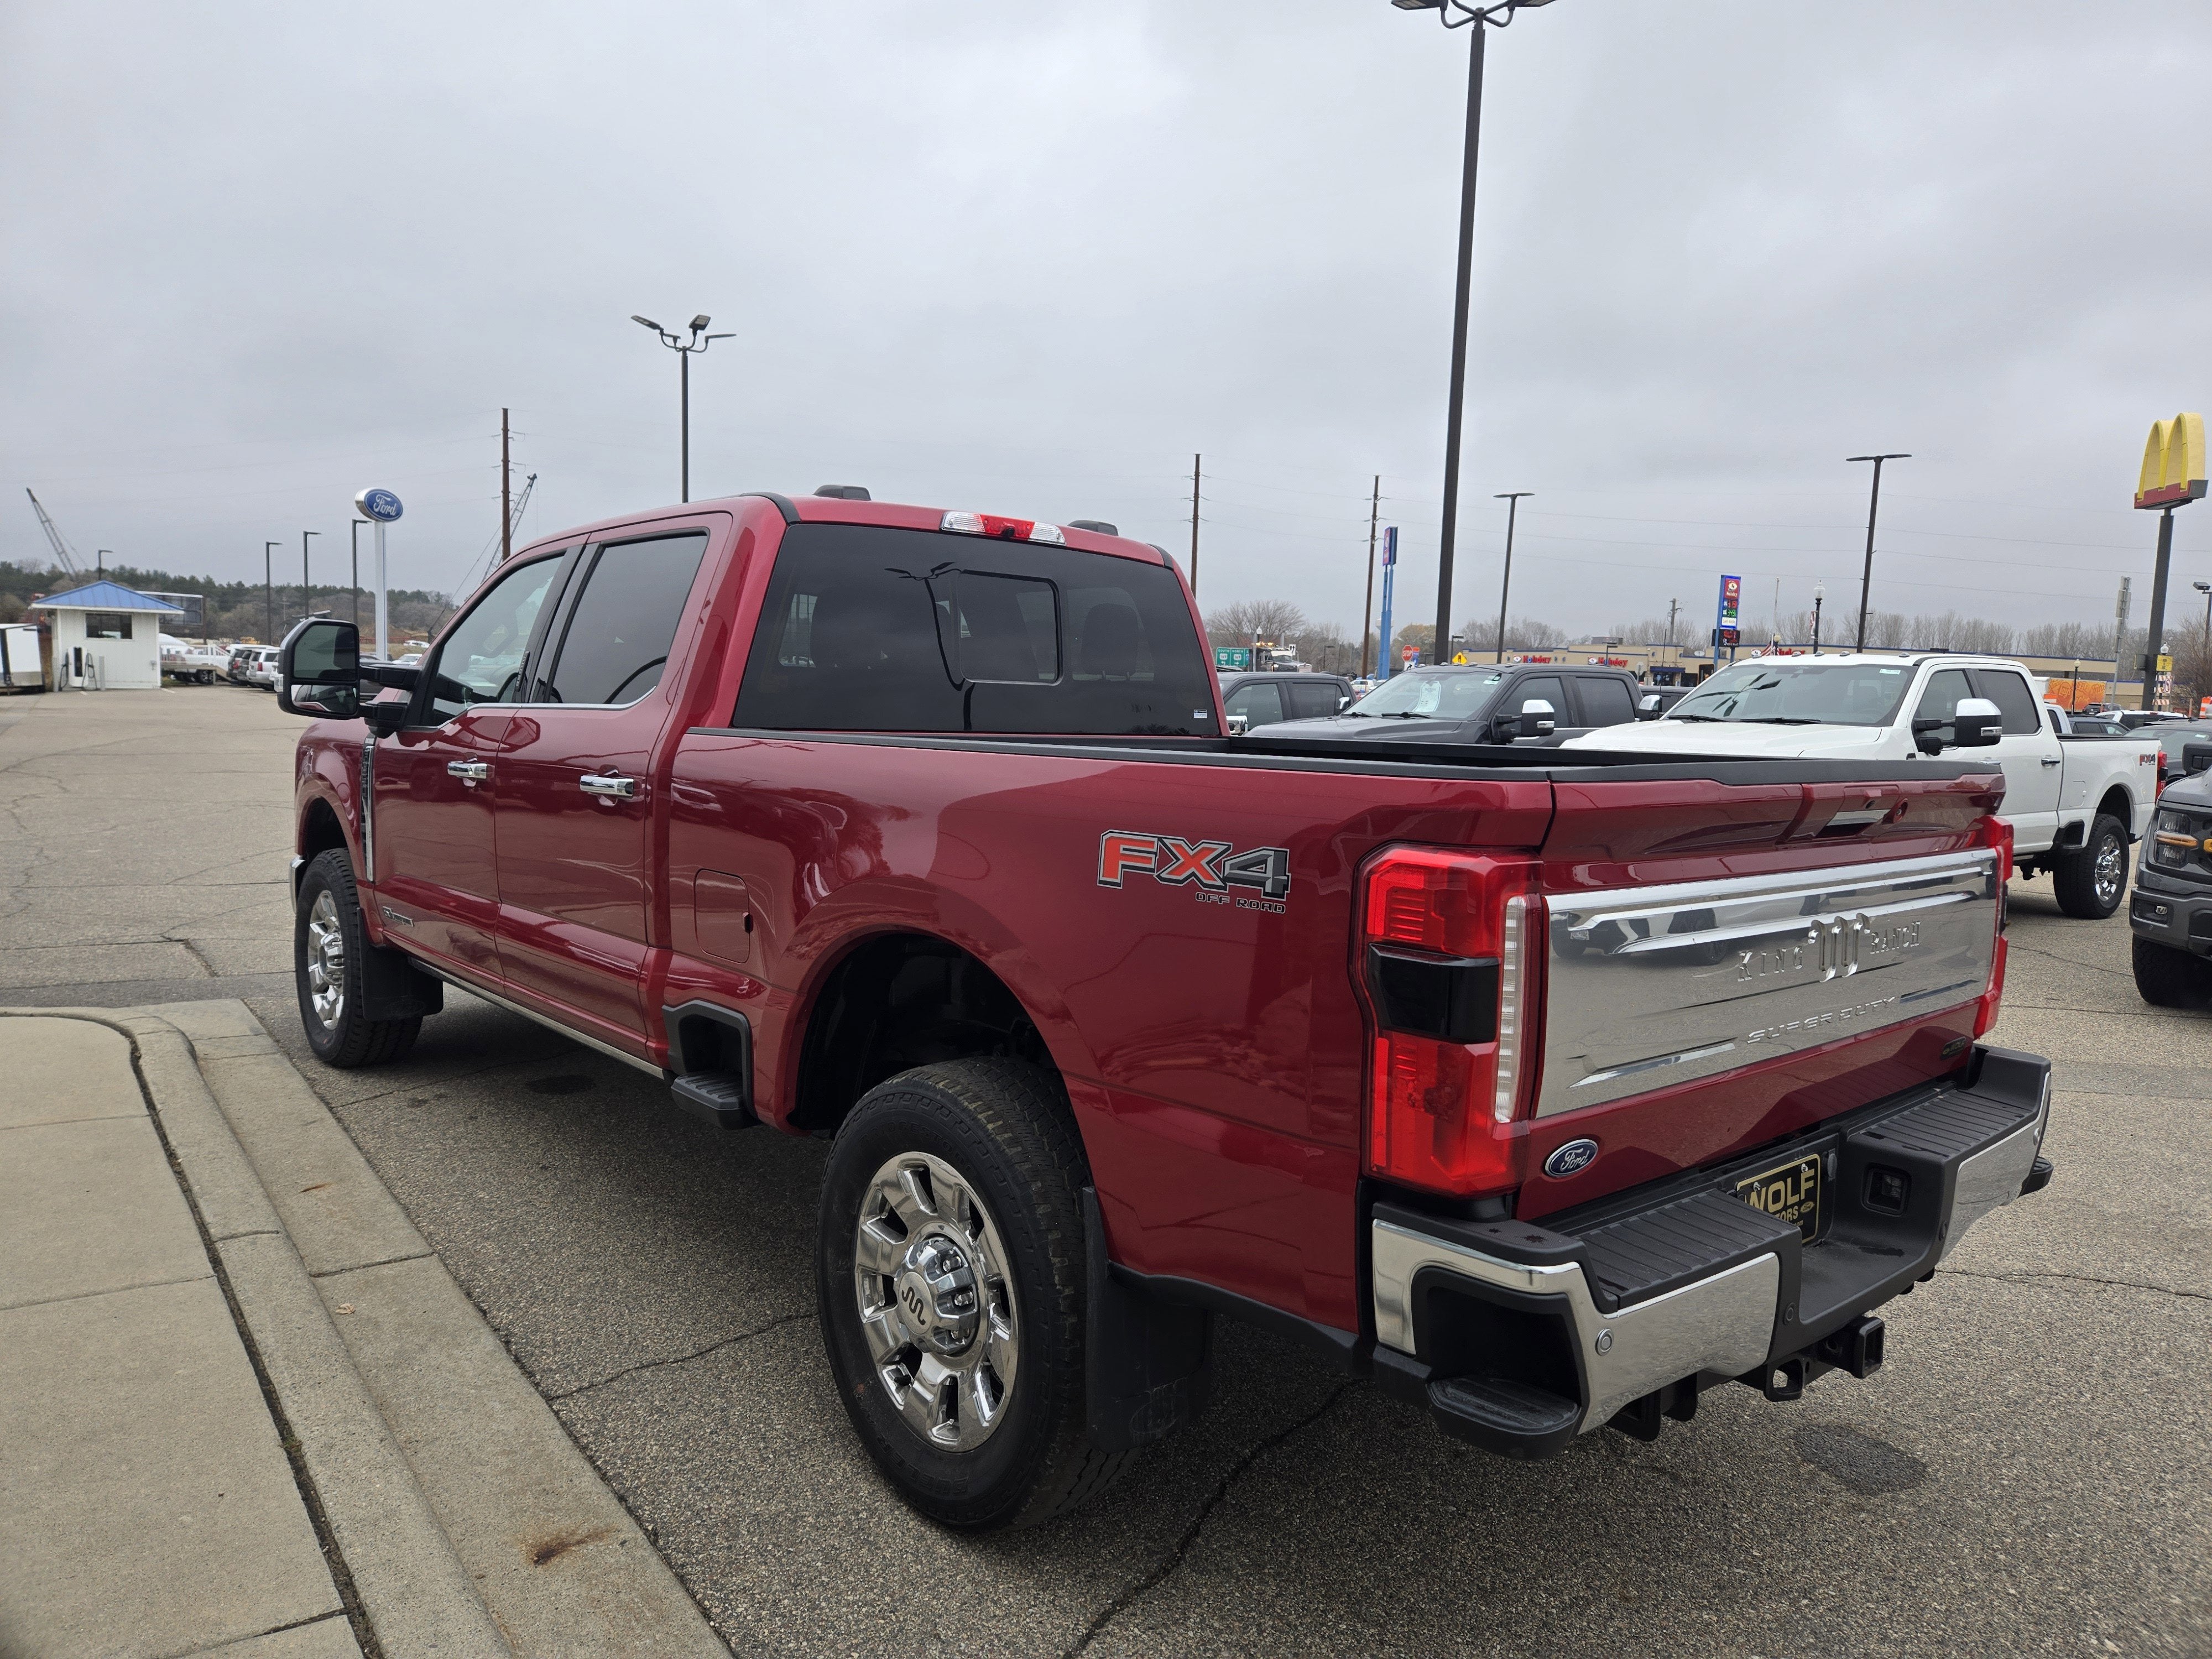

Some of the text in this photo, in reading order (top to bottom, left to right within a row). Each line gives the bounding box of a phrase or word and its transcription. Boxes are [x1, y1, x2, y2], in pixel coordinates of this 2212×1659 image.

[373, 494, 397, 515] Ford
[1522, 655, 1552, 664] Holiday
[1097, 830, 1292, 901] FX4
[1195, 891, 1286, 914] OFF ROAD
[1738, 920, 1921, 982] KING RANCH
[1747, 996, 1896, 1044] SUPER DUTY
[1560, 1147, 1590, 1172] Ford
[1744, 1168, 1815, 1213] WOLF
